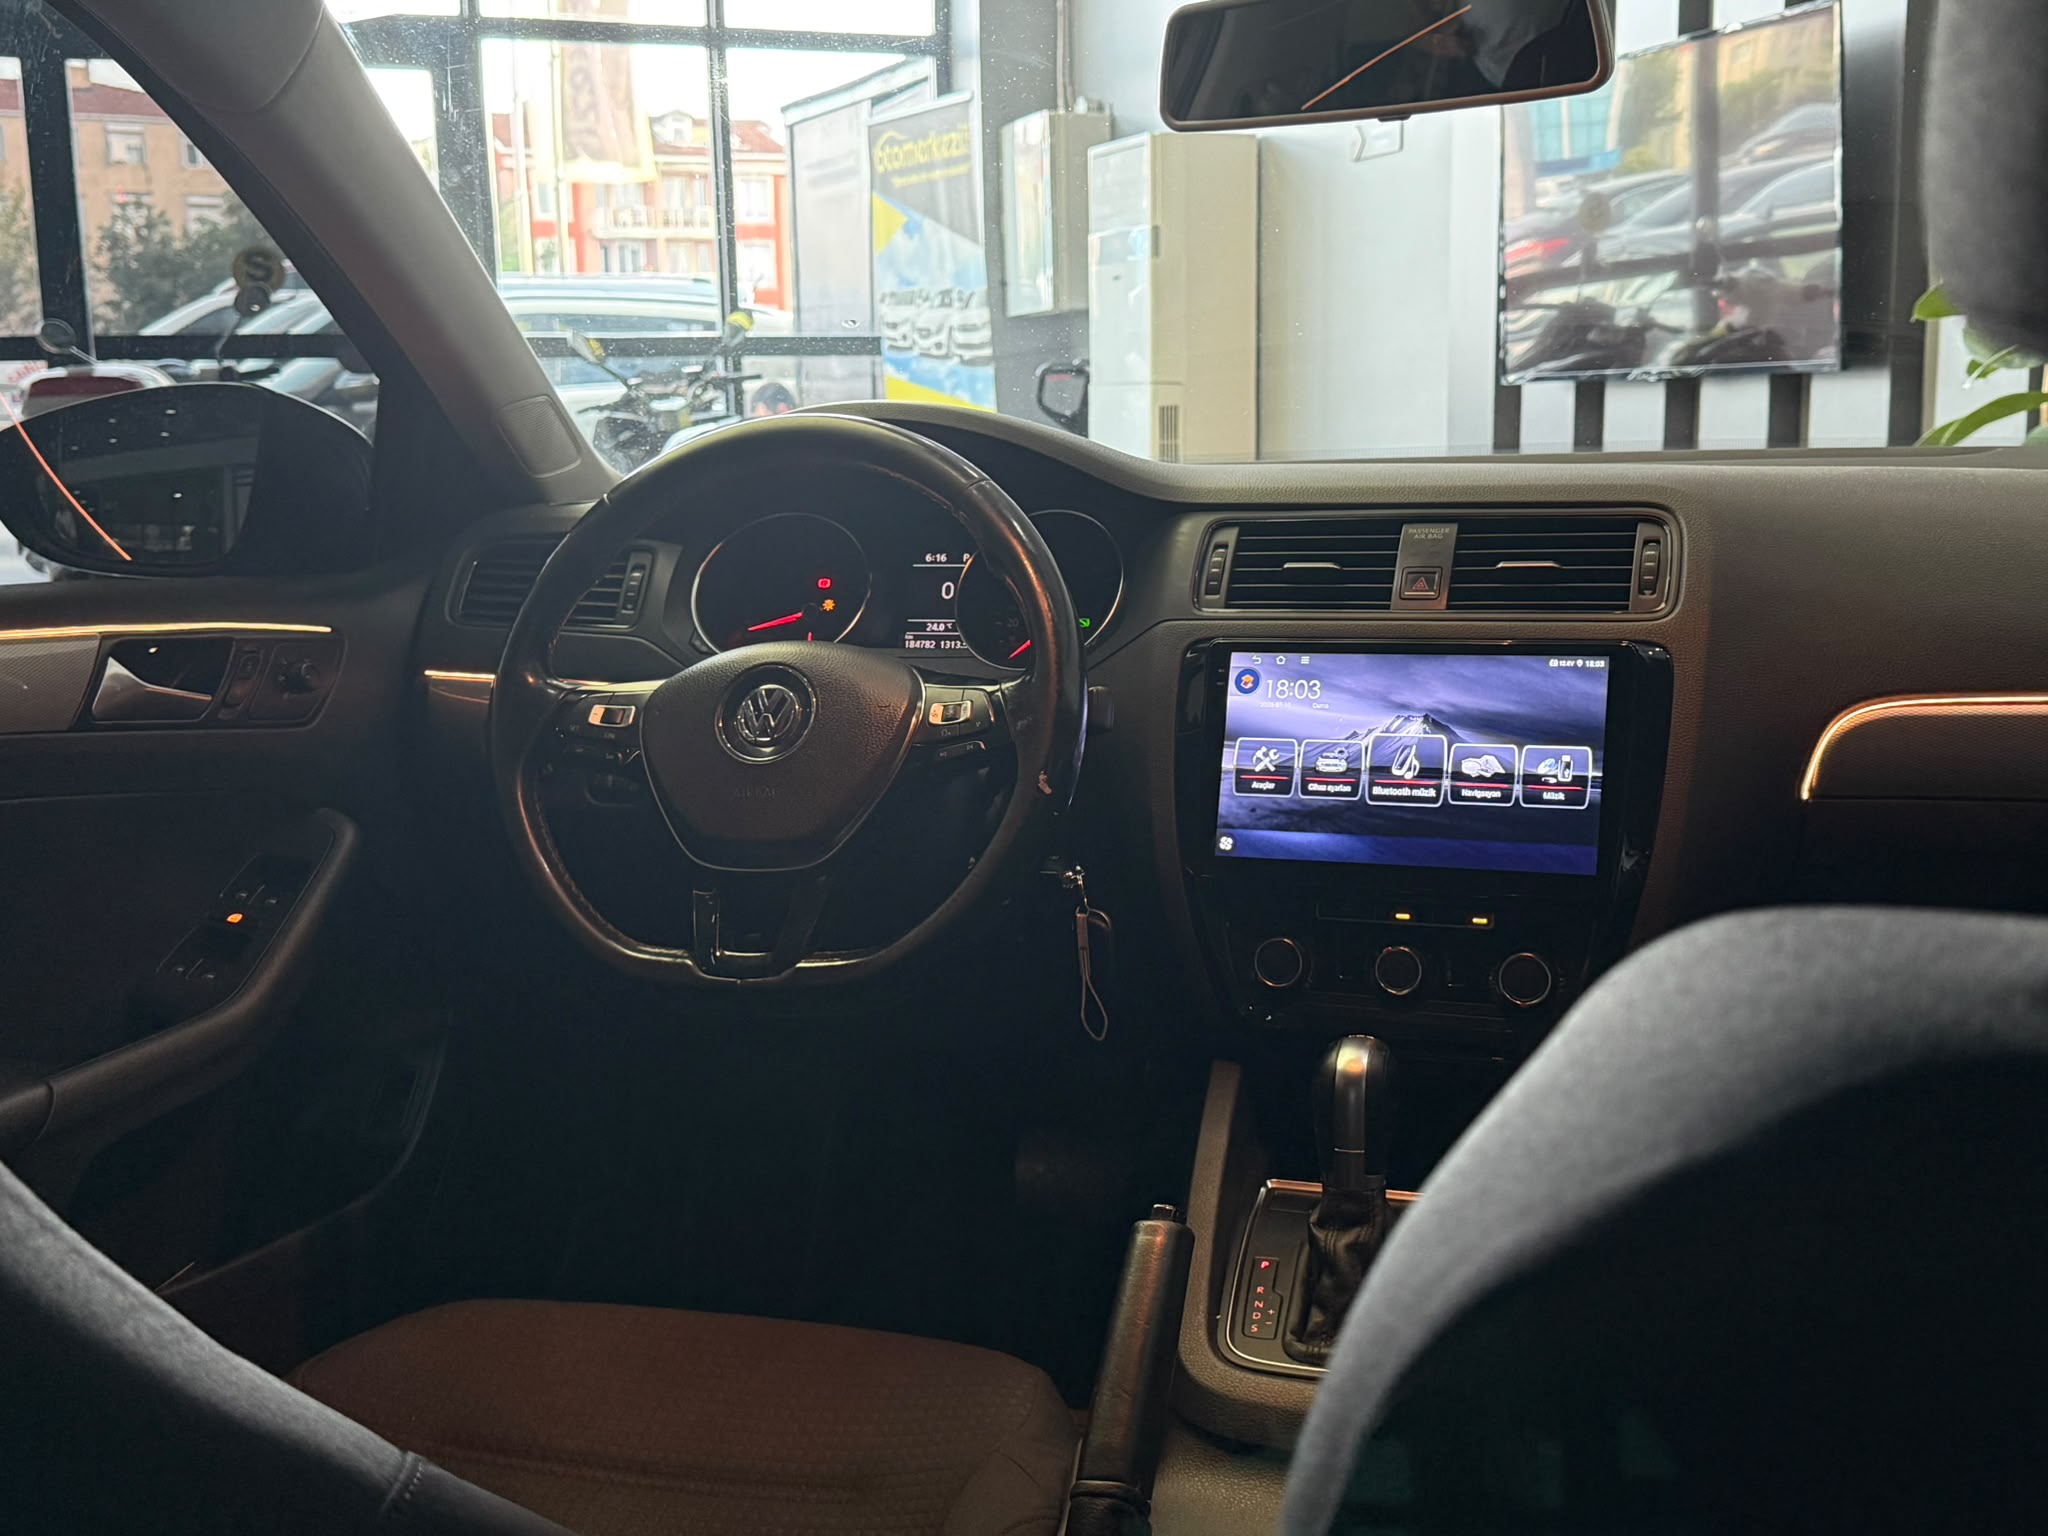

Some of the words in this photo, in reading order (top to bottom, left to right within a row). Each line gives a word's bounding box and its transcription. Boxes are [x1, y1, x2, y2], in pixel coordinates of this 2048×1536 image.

[925, 553, 948, 562] 6:16
[941, 581, 955, 600] 0
[926, 623, 946, 631] 24.0
[905, 640, 936, 649] 184782
[1266, 679, 1321, 700] 18:03
[1372, 785, 1411, 797] Bluetooth
[1412, 787, 1436, 798] müzik
[1260, 1260, 1270, 1270] P
[1256, 1286, 1265, 1294] R
[1254, 1300, 1264, 1309] N
[1252, 1311, 1262, 1320] D
[1251, 1324, 1259, 1333] S
